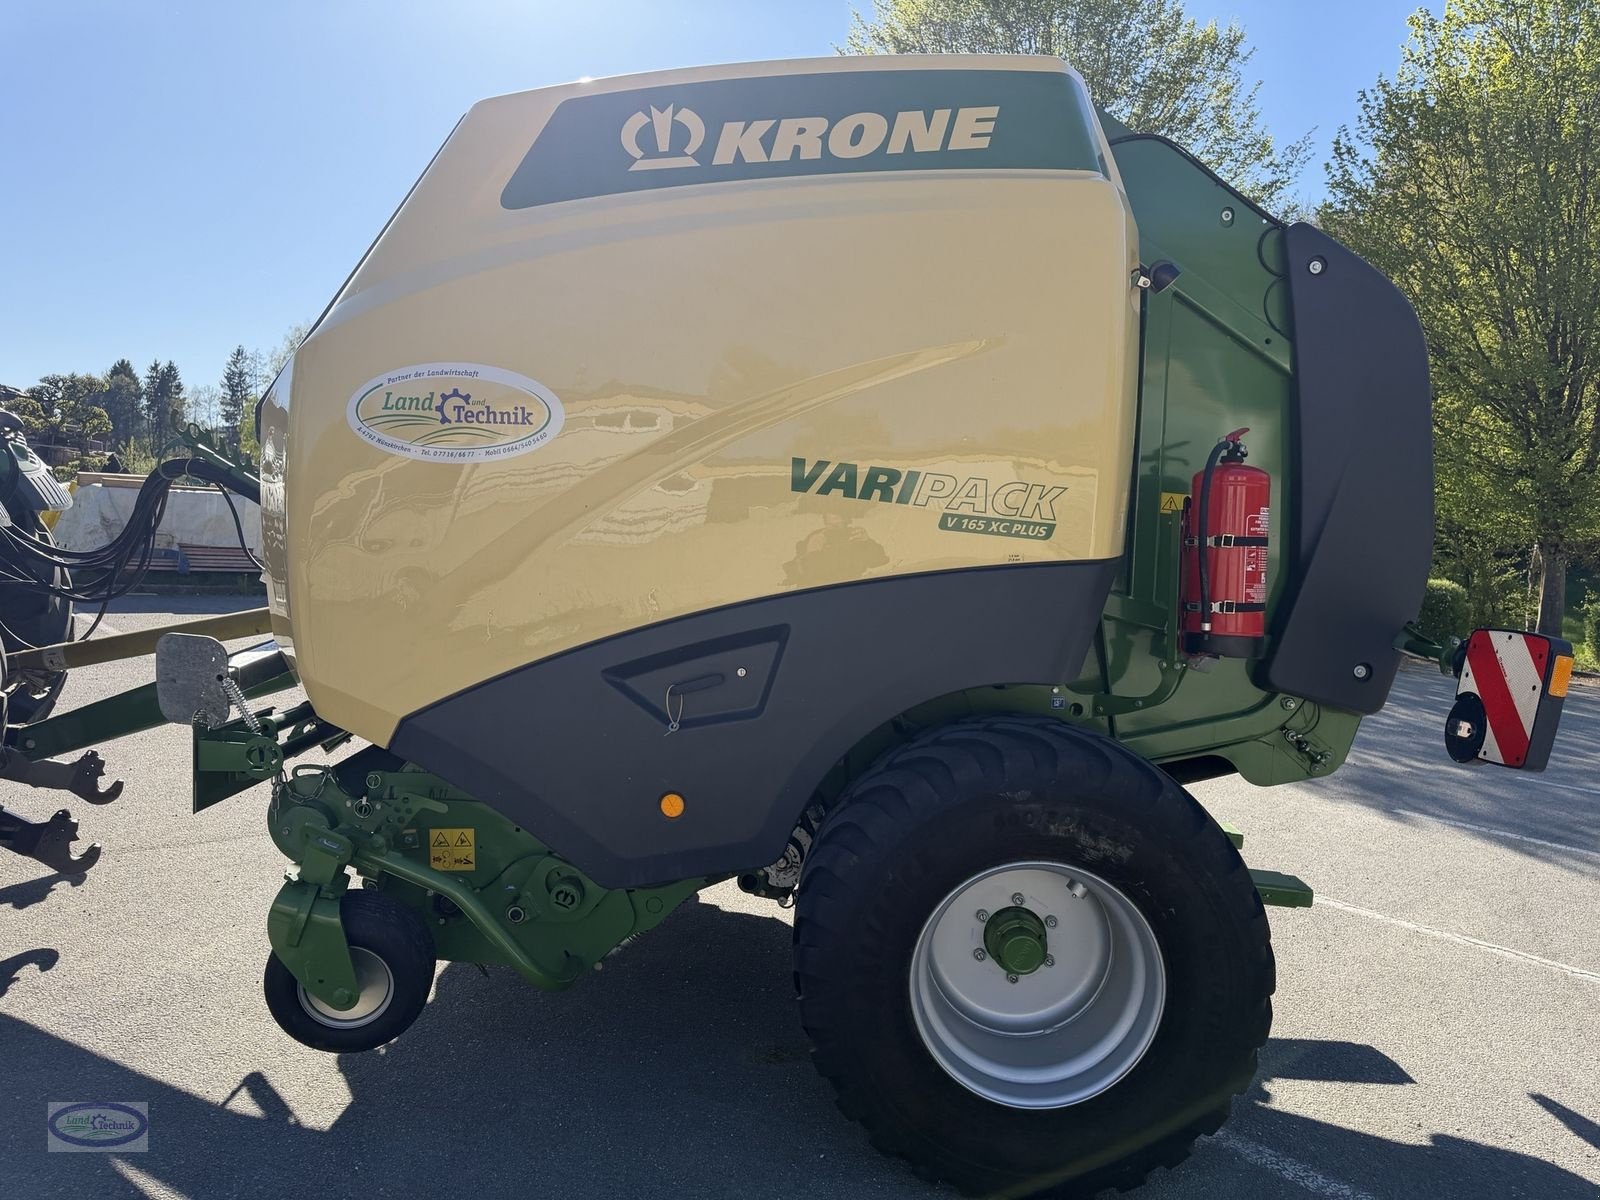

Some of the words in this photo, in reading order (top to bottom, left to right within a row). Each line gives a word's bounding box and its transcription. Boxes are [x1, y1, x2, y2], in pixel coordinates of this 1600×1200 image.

[712, 106, 1000, 165] KRONE
[387, 374, 412, 384] Partner
[413, 370, 425, 378] der
[427, 369, 479, 378] Landwirtschaft
[381, 391, 435, 411] Land
[471, 398, 487, 406] und
[453, 405, 534, 425] Technik
[376, 438, 411, 453] Münzkirchen
[421, 449, 432, 457] Tel.
[485, 449, 501, 457] Mobil
[946, 516, 957, 528] V
[960, 518, 985, 531] 165
[988, 521, 1010, 534] XC
[1011, 523, 1048, 538] PLUS
